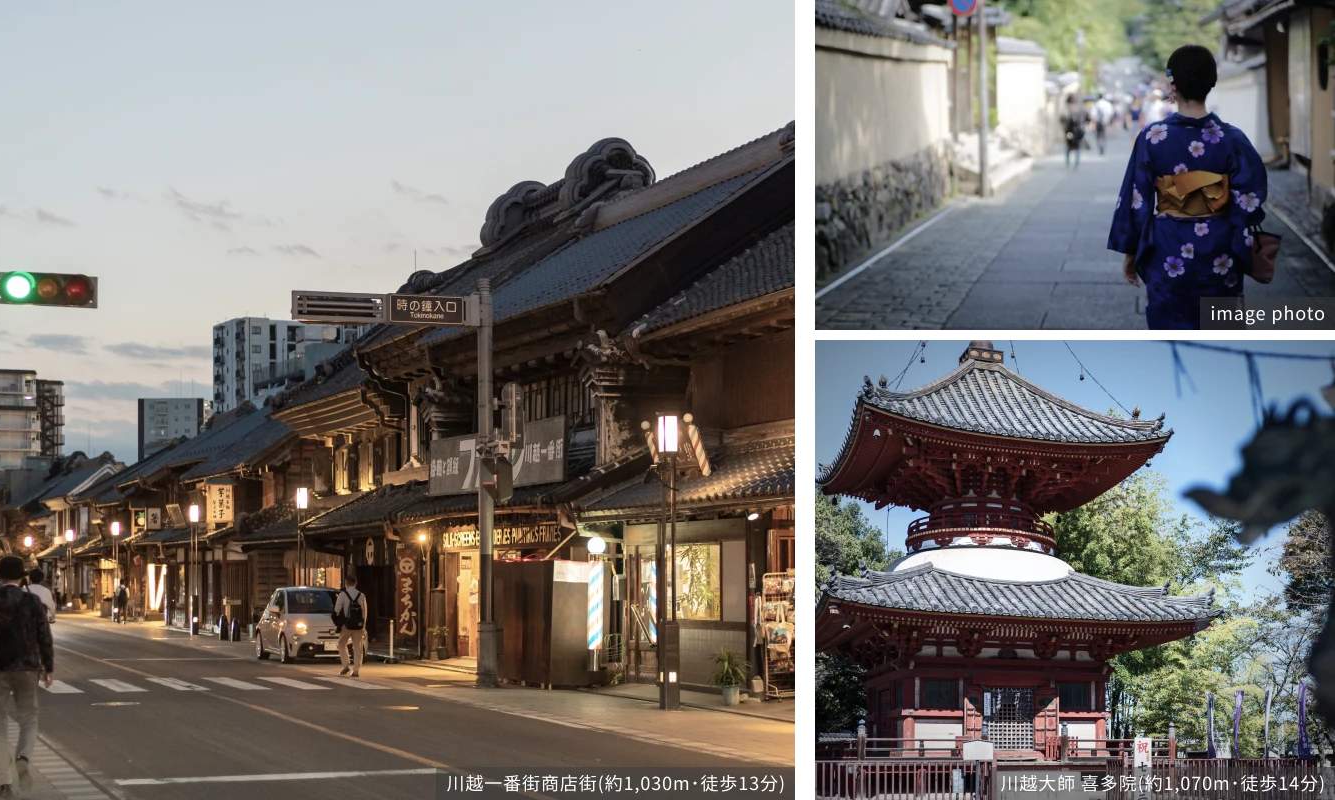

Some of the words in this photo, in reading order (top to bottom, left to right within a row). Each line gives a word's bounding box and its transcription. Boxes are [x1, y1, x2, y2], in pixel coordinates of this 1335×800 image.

[396, 298, 457, 313] 時の鐘入口
[410, 311, 445, 319] Tokinokane
[400, 577, 418, 636] まちかん
[1136, 740, 1150, 754] 祝
